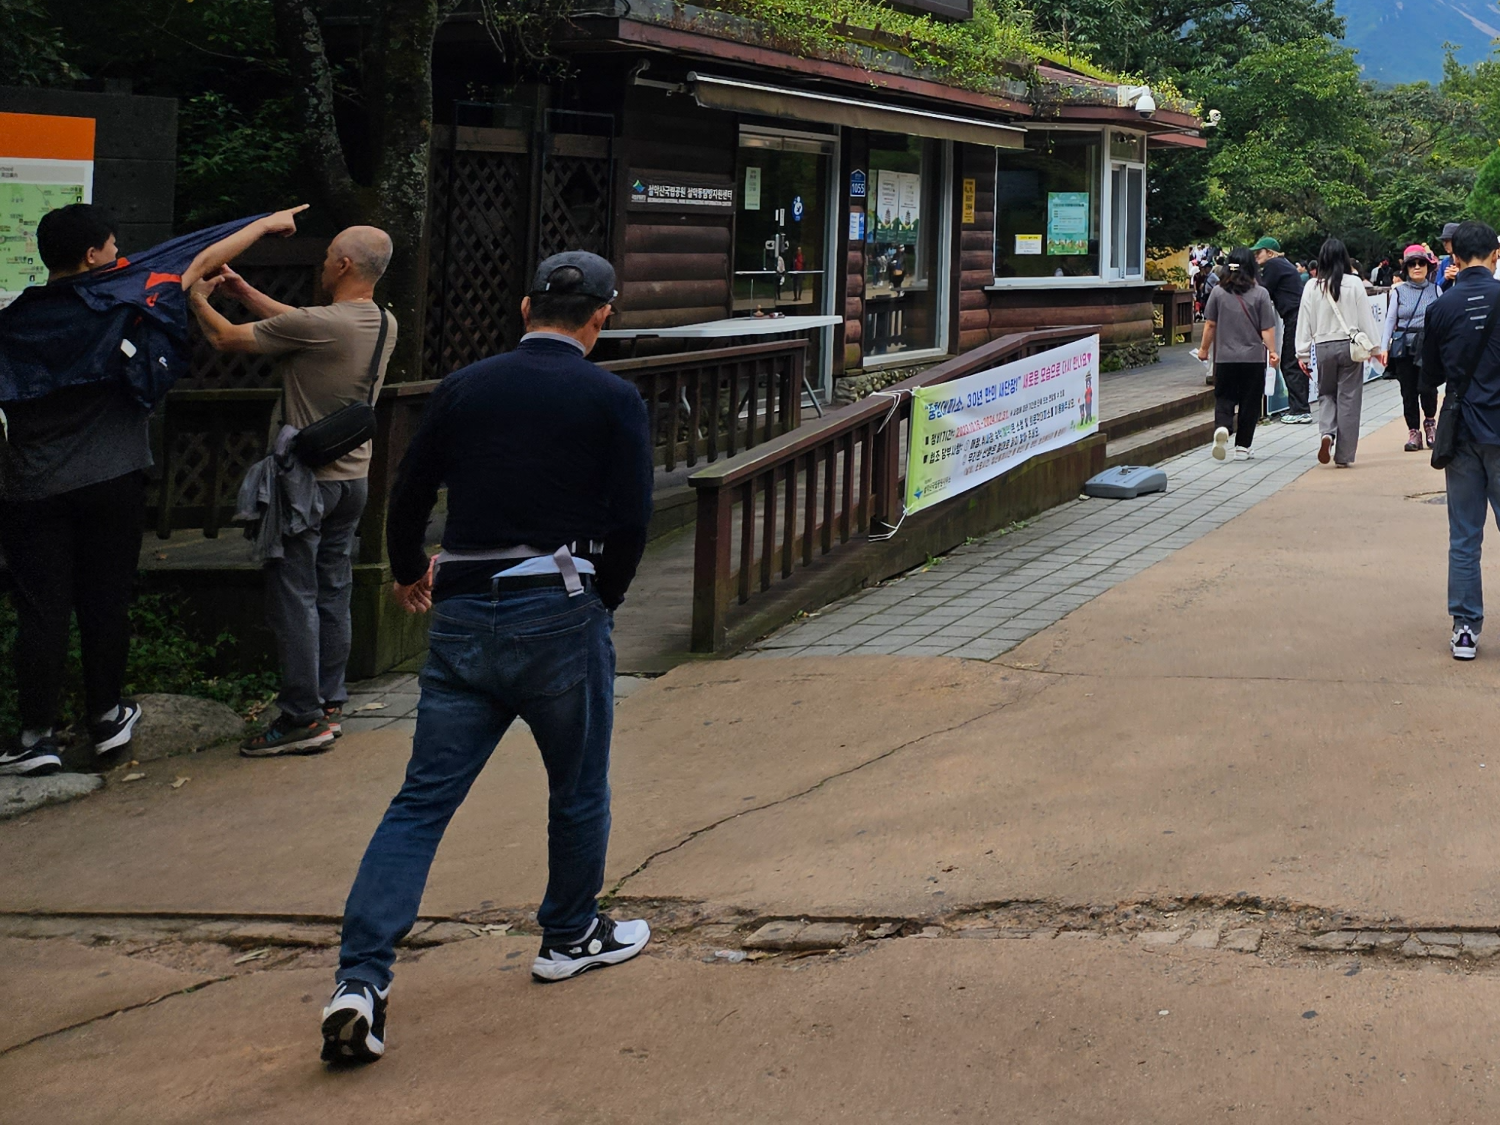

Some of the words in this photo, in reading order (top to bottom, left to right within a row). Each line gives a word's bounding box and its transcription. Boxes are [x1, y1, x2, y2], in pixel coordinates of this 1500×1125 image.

[648, 184, 686, 198] 설악산국립공원
[851, 182, 865, 194] 1055
[966, 389, 983, 408] 30년
[1023, 370, 1039, 389] 새로운
[1040, 362, 1061, 383] 모습으로
